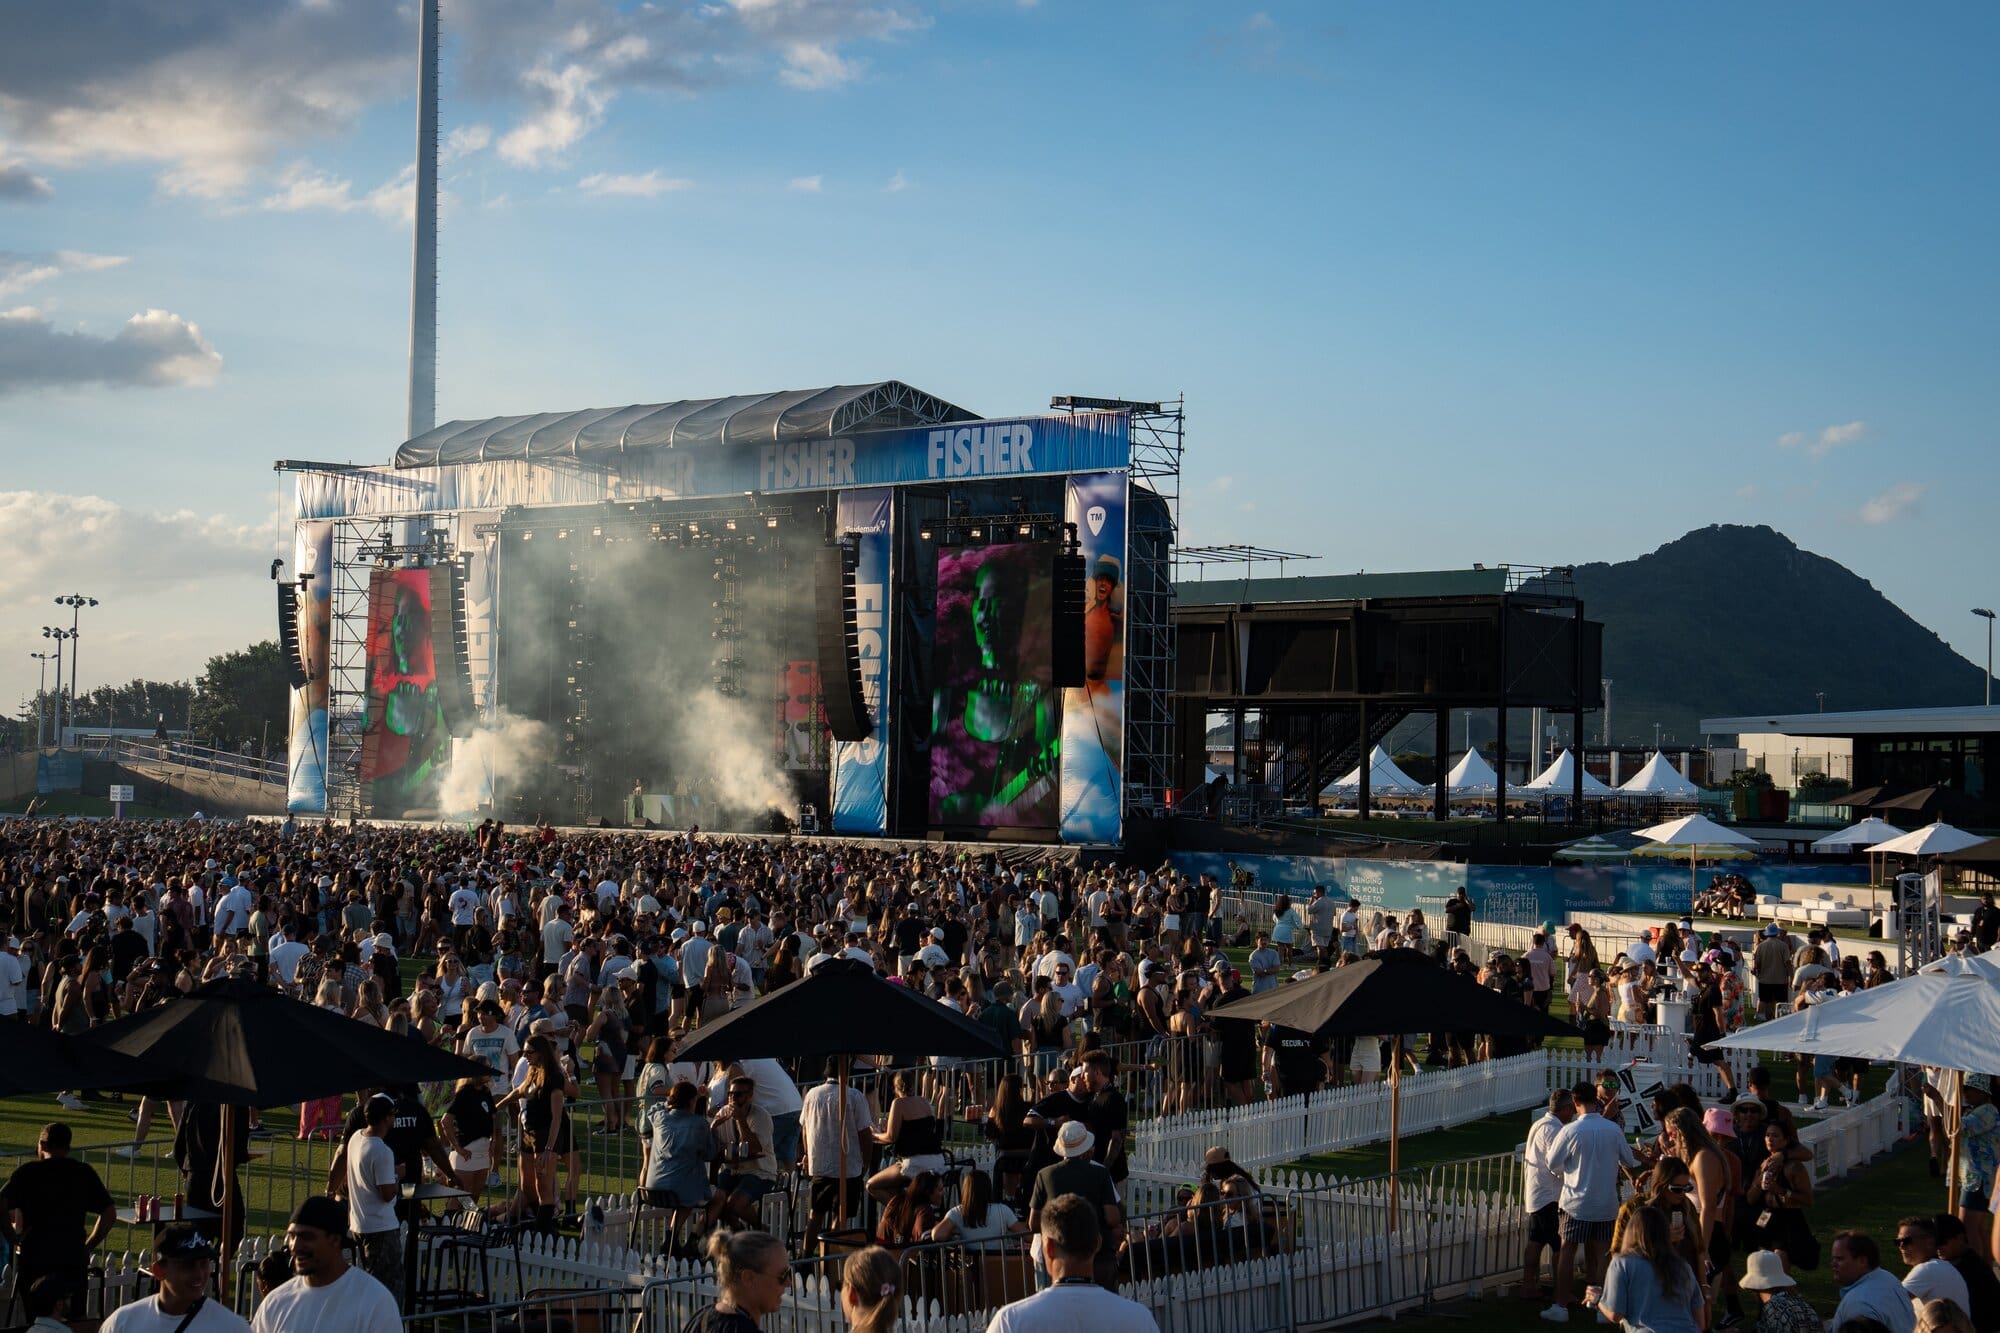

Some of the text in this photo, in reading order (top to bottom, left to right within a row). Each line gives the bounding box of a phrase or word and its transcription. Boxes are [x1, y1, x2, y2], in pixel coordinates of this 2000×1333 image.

[760, 439, 855, 490] FISHER
[927, 424, 1033, 478] FISHER
[1090, 513, 1102, 521] TM
[844, 525, 881, 533] Trademark
[1351, 875, 1383, 885] BRINGING
[1349, 885, 1385, 895] THE WORLD
[1488, 882, 1536, 891] BRINGING
[1652, 882, 1693, 891] BRINGING
[1372, 895, 1382, 904] TO
[1649, 892, 1693, 901] THE WORL
[1564, 898, 1610, 908] Trademark
[1653, 901, 1681, 911] STAGE
